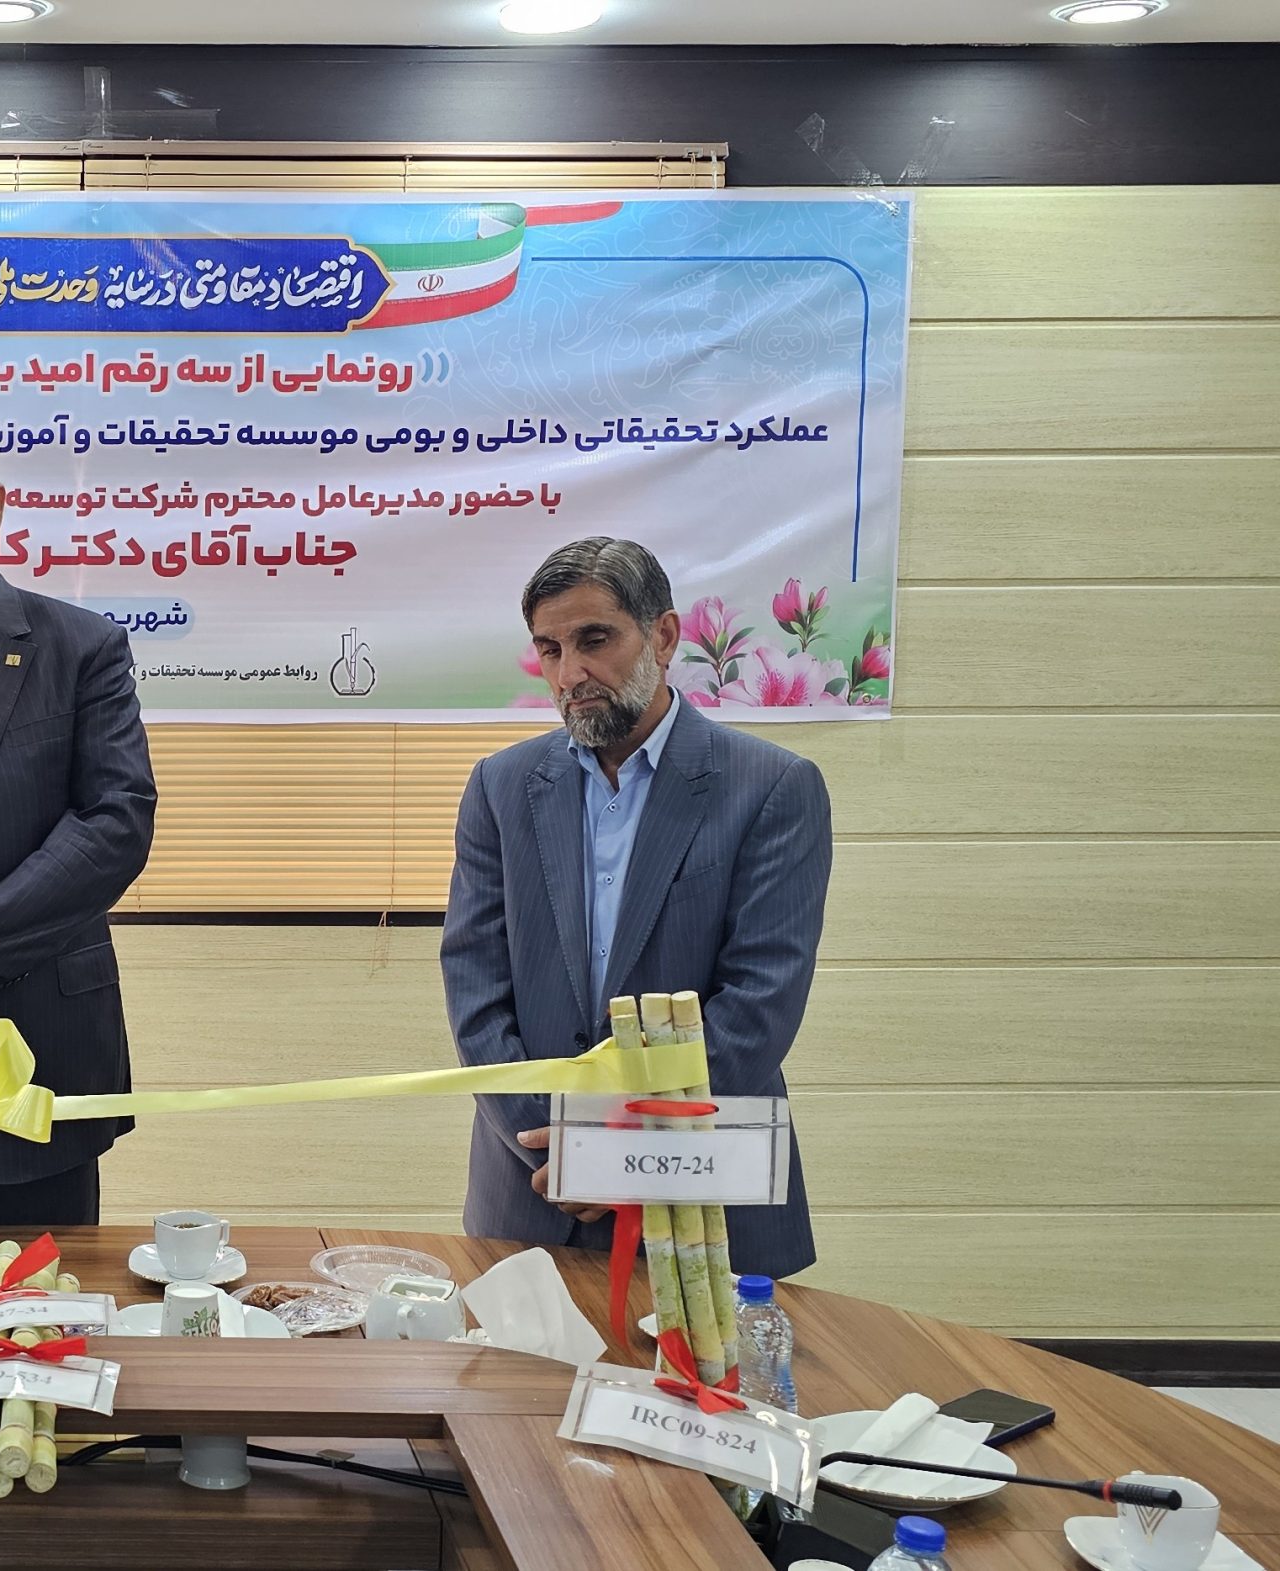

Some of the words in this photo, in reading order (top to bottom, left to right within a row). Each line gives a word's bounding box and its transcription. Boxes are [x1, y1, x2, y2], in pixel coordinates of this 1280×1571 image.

[22, 353, 95, 393] امید
[101, 351, 169, 393] رقم
[176, 357, 232, 384] سه
[236, 353, 265, 393] از
[73, 427, 92, 454] و
[98, 418, 231, 453] تحقیقات
[236, 423, 359, 454] موسسه
[365, 427, 446, 454] بومی
[451, 427, 470, 453] و
[475, 417, 568, 453] داخلی
[574, 416, 720, 452] تحقیقاتی
[724, 415, 830, 451] عملکرد
[6, 487, 108, 517] توسعه
[111, 481, 199, 517] شرکت
[204, 487, 297, 517] محترم
[448, 482, 536, 516] حضور
[539, 482, 562, 515] با
[33, 528, 147, 578] دکتر
[151, 524, 252, 578] آقای
[253, 531, 358, 577] جناب
[149, 664, 196, 680] تحقیقات
[197, 665, 238, 681] موسسه
[239, 667, 281, 681] عمومی
[283, 664, 318, 681] روابط
[623, 1154, 716, 1175] 8C87-24
[630, 1404, 757, 1454] IRC09-824
